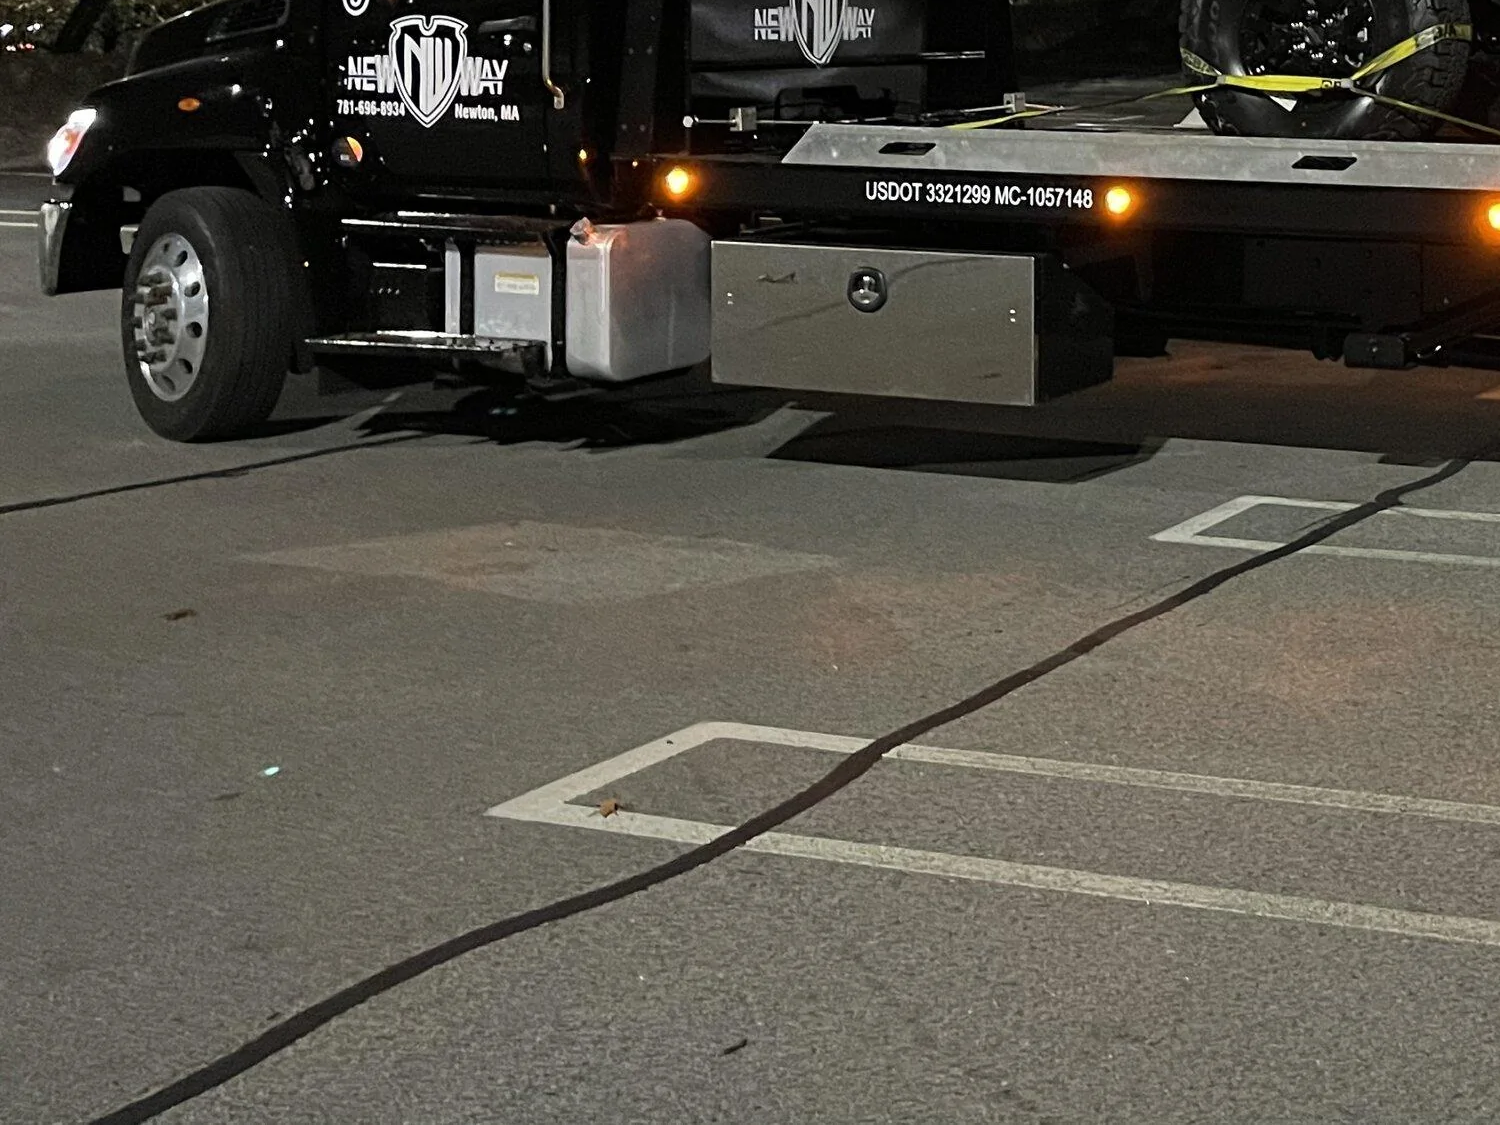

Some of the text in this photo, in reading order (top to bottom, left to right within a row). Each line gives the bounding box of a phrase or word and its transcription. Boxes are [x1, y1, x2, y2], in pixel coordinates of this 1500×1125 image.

[754, 6, 796, 42] NEW
[841, 6, 876, 42] WAY
[347, 54, 397, 94] NEW
[459, 56, 509, 97] WAY
[336, 99, 406, 117] 781-696-8934
[454, 102, 520, 123] Newton, MA
[865, 180, 1094, 209] USDOT 3321299 MC-1057148
